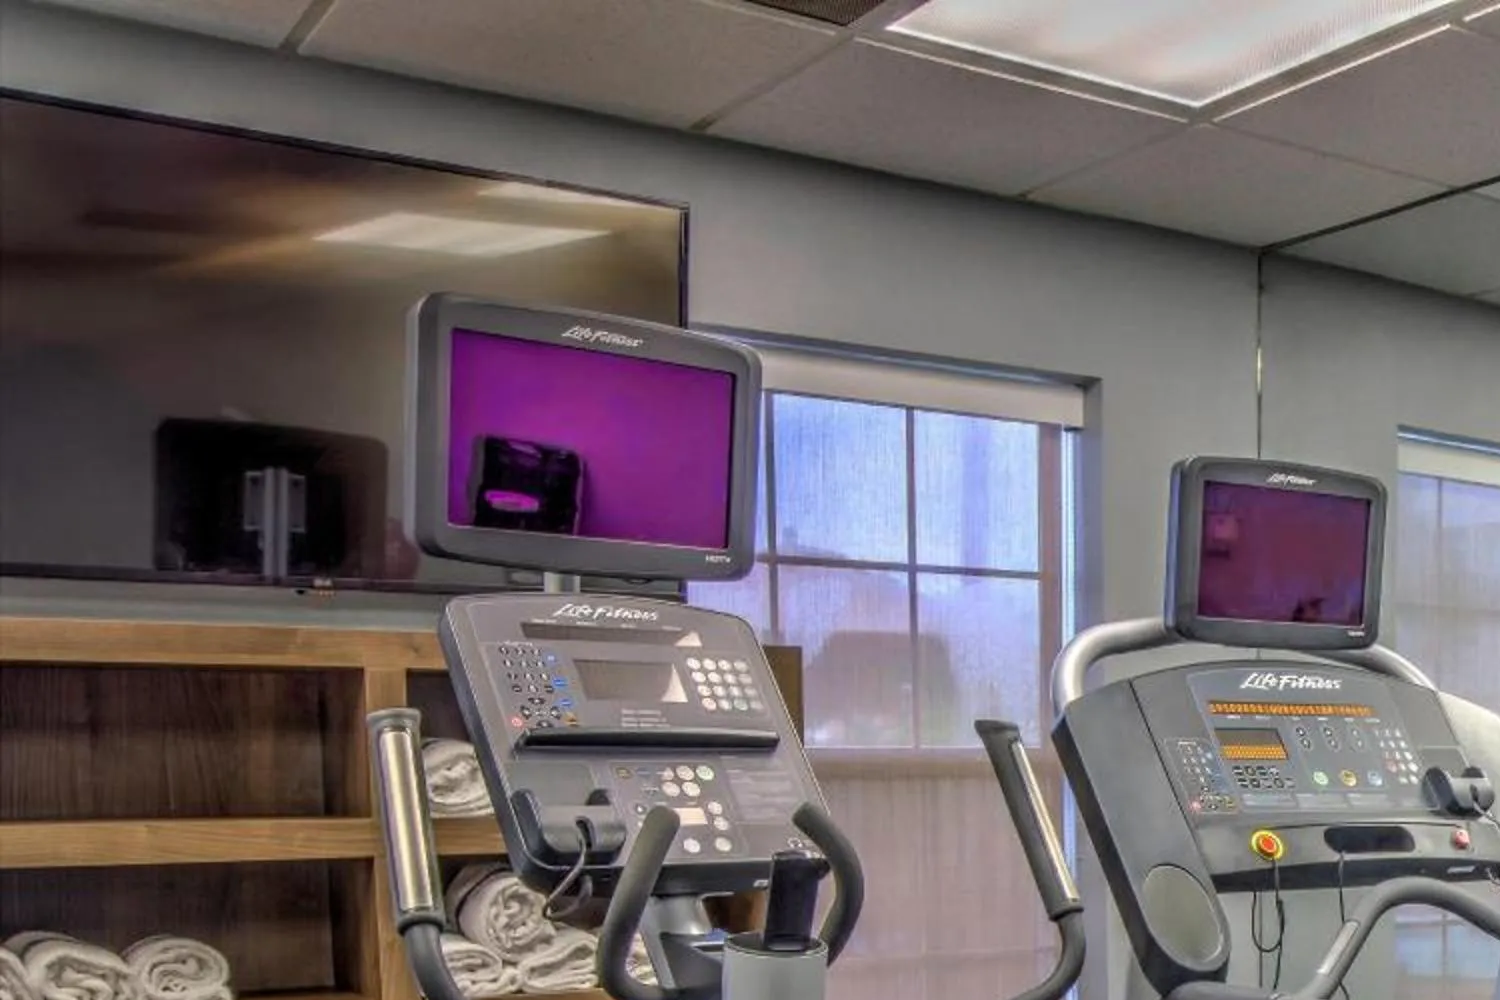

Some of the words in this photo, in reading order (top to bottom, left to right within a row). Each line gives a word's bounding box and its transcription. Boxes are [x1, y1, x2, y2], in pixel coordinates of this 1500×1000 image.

[552, 603, 593, 618] Life
[1240, 672, 1278, 690] Life
[1278, 675, 1342, 691] Fitness
